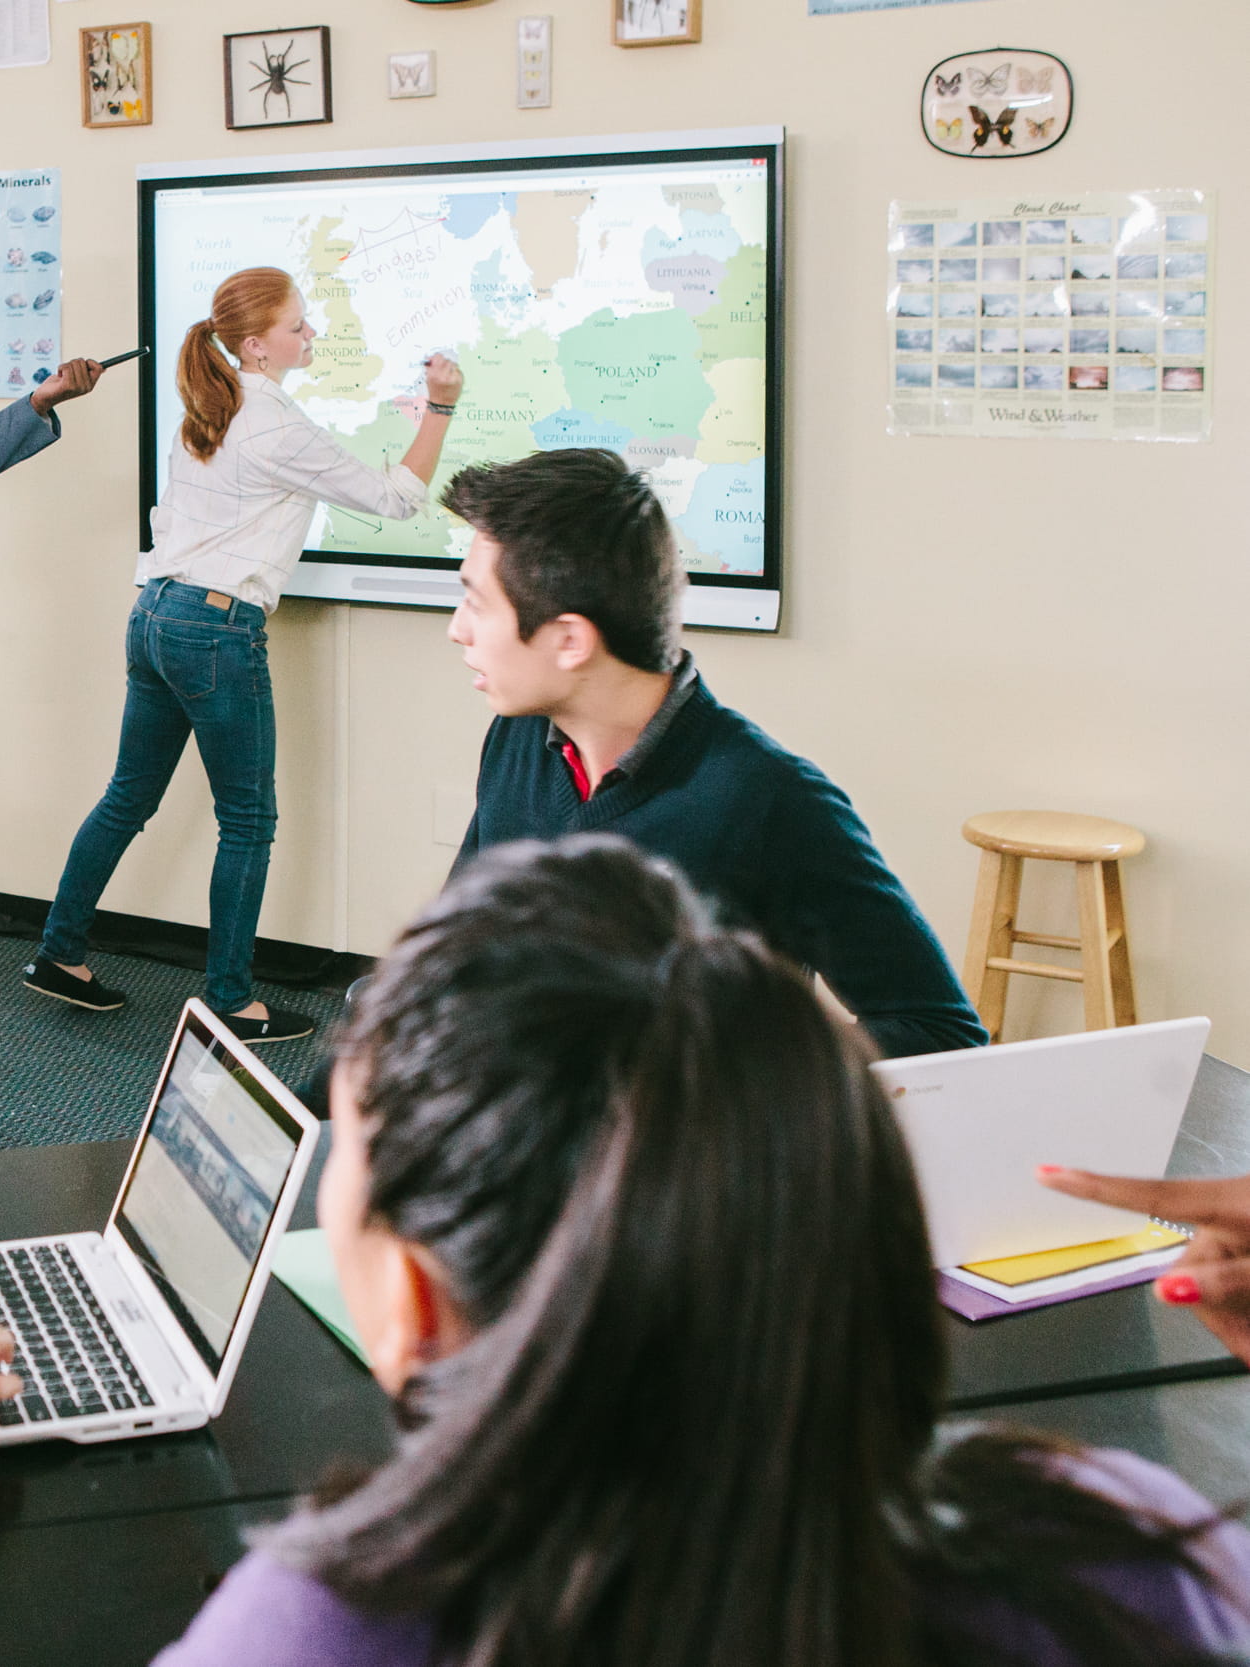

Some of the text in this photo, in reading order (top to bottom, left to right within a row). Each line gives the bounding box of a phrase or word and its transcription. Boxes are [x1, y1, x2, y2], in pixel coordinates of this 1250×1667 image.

[670, 190, 714, 200] ESTONIA
[1013, 201, 1081, 217] Cloud Chart
[688, 229, 725, 239] LATVIA
[194, 237, 233, 250] North
[659, 239, 677, 249] Riga
[398, 269, 430, 281] North
[657, 267, 711, 279] LITHUANIA
[314, 286, 357, 298] UNITED
[470, 283, 518, 293] DENMARK
[681, 282, 706, 291] Vilnius
[403, 287, 423, 299] Sea
[385, 283, 467, 348] Emmerich
[729, 311, 766, 323] BELA
[313, 347, 368, 358] KINGDOM
[649, 353, 677, 362] Warsaw
[597, 366, 658, 378] POLAND
[331, 385, 355, 393] London
[466, 408, 537, 422] GERMANY
[988, 408, 1026, 422] Wind
[1044, 408, 1099, 422] Weather
[555, 416, 581, 428] Prague
[542, 434, 623, 444] CZECH REPUBLIC
[387, 441, 403, 450] Paris
[628, 446, 677, 456] SLOVAKIA
[714, 509, 765, 524] ROMA
